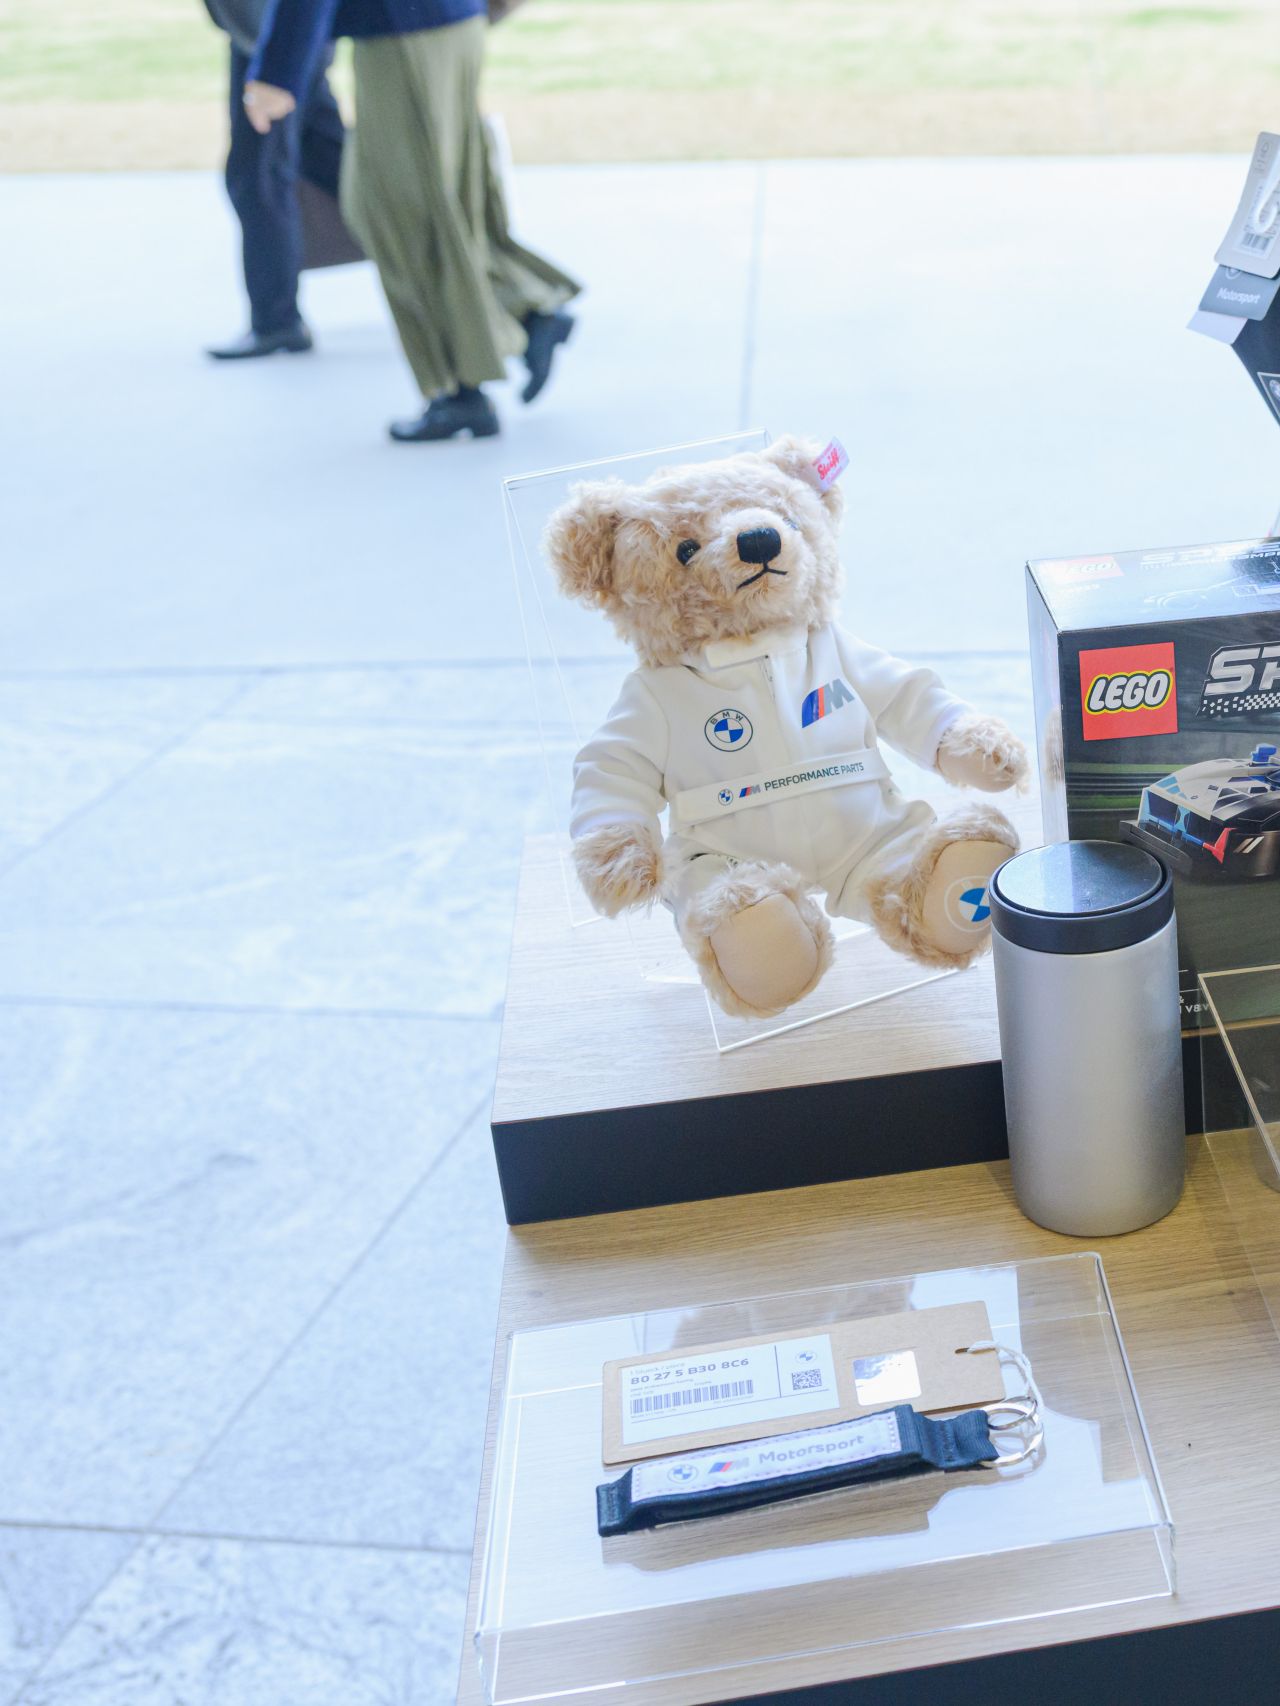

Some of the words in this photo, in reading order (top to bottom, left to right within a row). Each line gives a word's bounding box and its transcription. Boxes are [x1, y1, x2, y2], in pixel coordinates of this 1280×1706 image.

[1090, 672, 1169, 712] LEGO
[764, 766, 840, 791] PERFORMANCE
[840, 762, 864, 775] PARTS
[630, 1375, 650, 1385] 80
[654, 1371, 671, 1381] 27
[675, 1369, 683, 1377] 5
[688, 1363, 716, 1375] B30
[721, 1358, 749, 1369] 8C6
[758, 1435, 864, 1465] Motorsport
